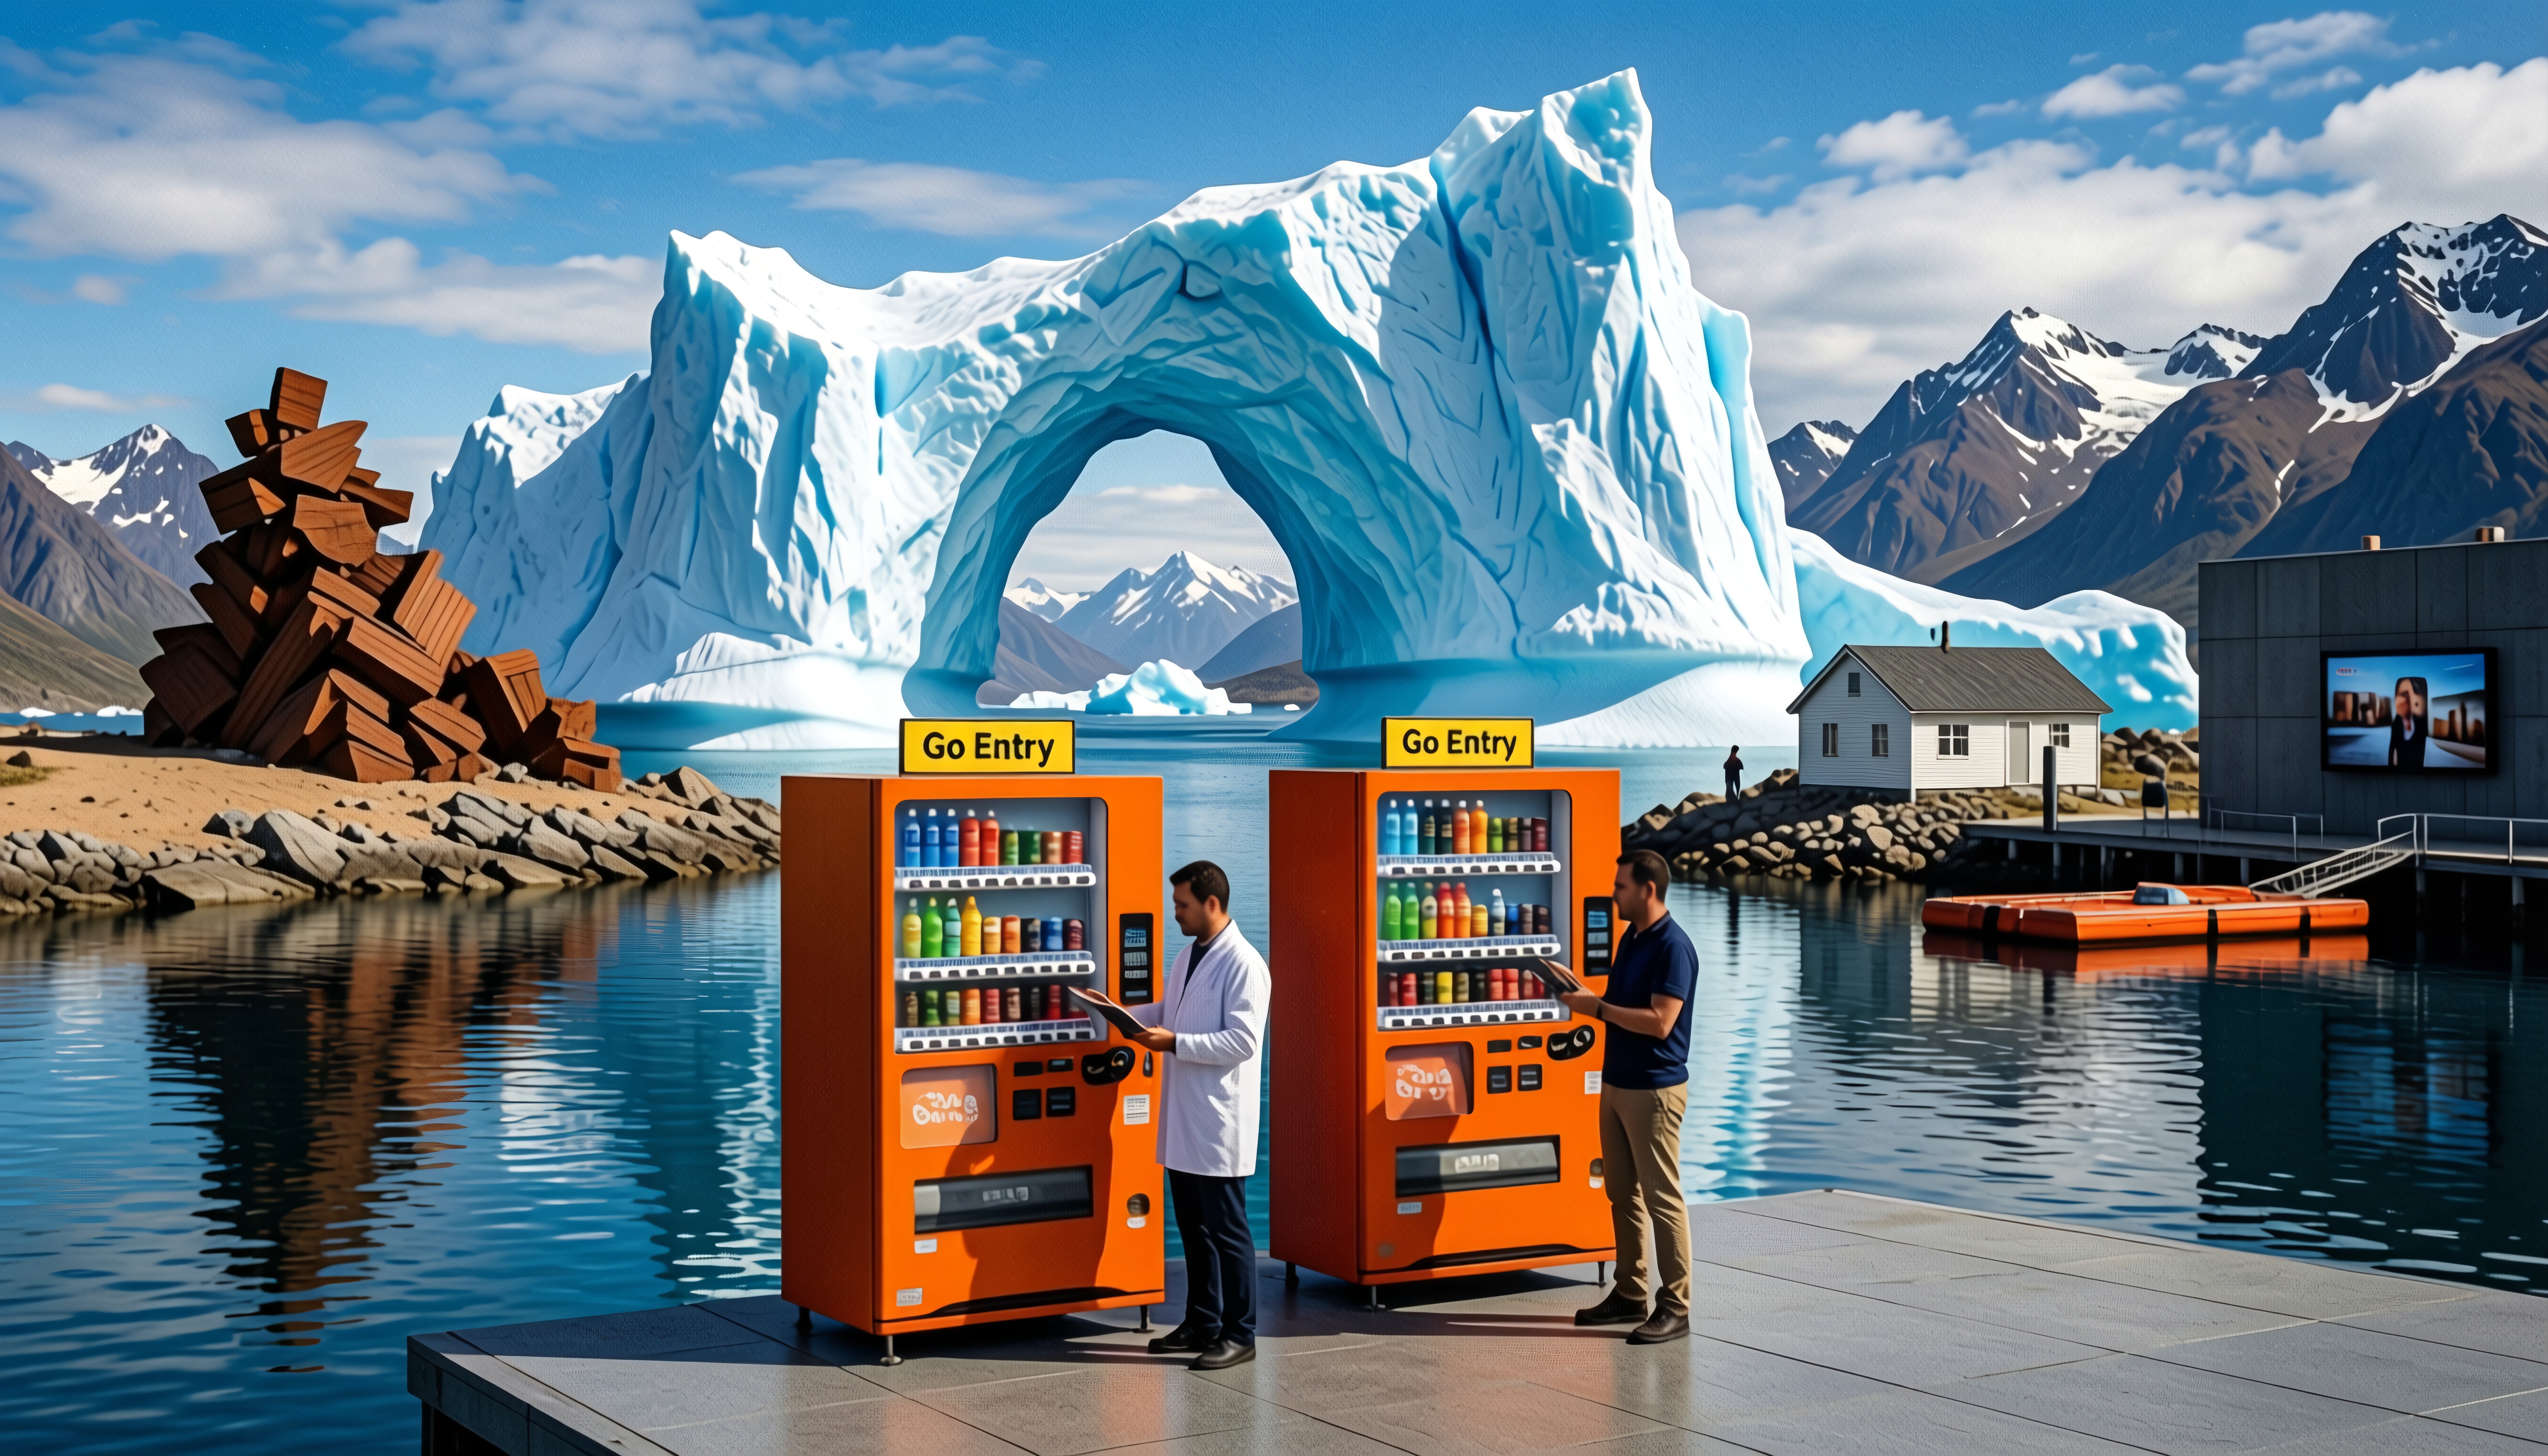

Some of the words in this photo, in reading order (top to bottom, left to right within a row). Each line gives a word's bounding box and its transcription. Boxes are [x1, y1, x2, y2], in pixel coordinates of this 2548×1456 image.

[923, 731, 965, 760] Go
[975, 732, 1055, 768] Entry
[1402, 728, 1439, 754] Go
[1447, 729, 1517, 762] Entry
